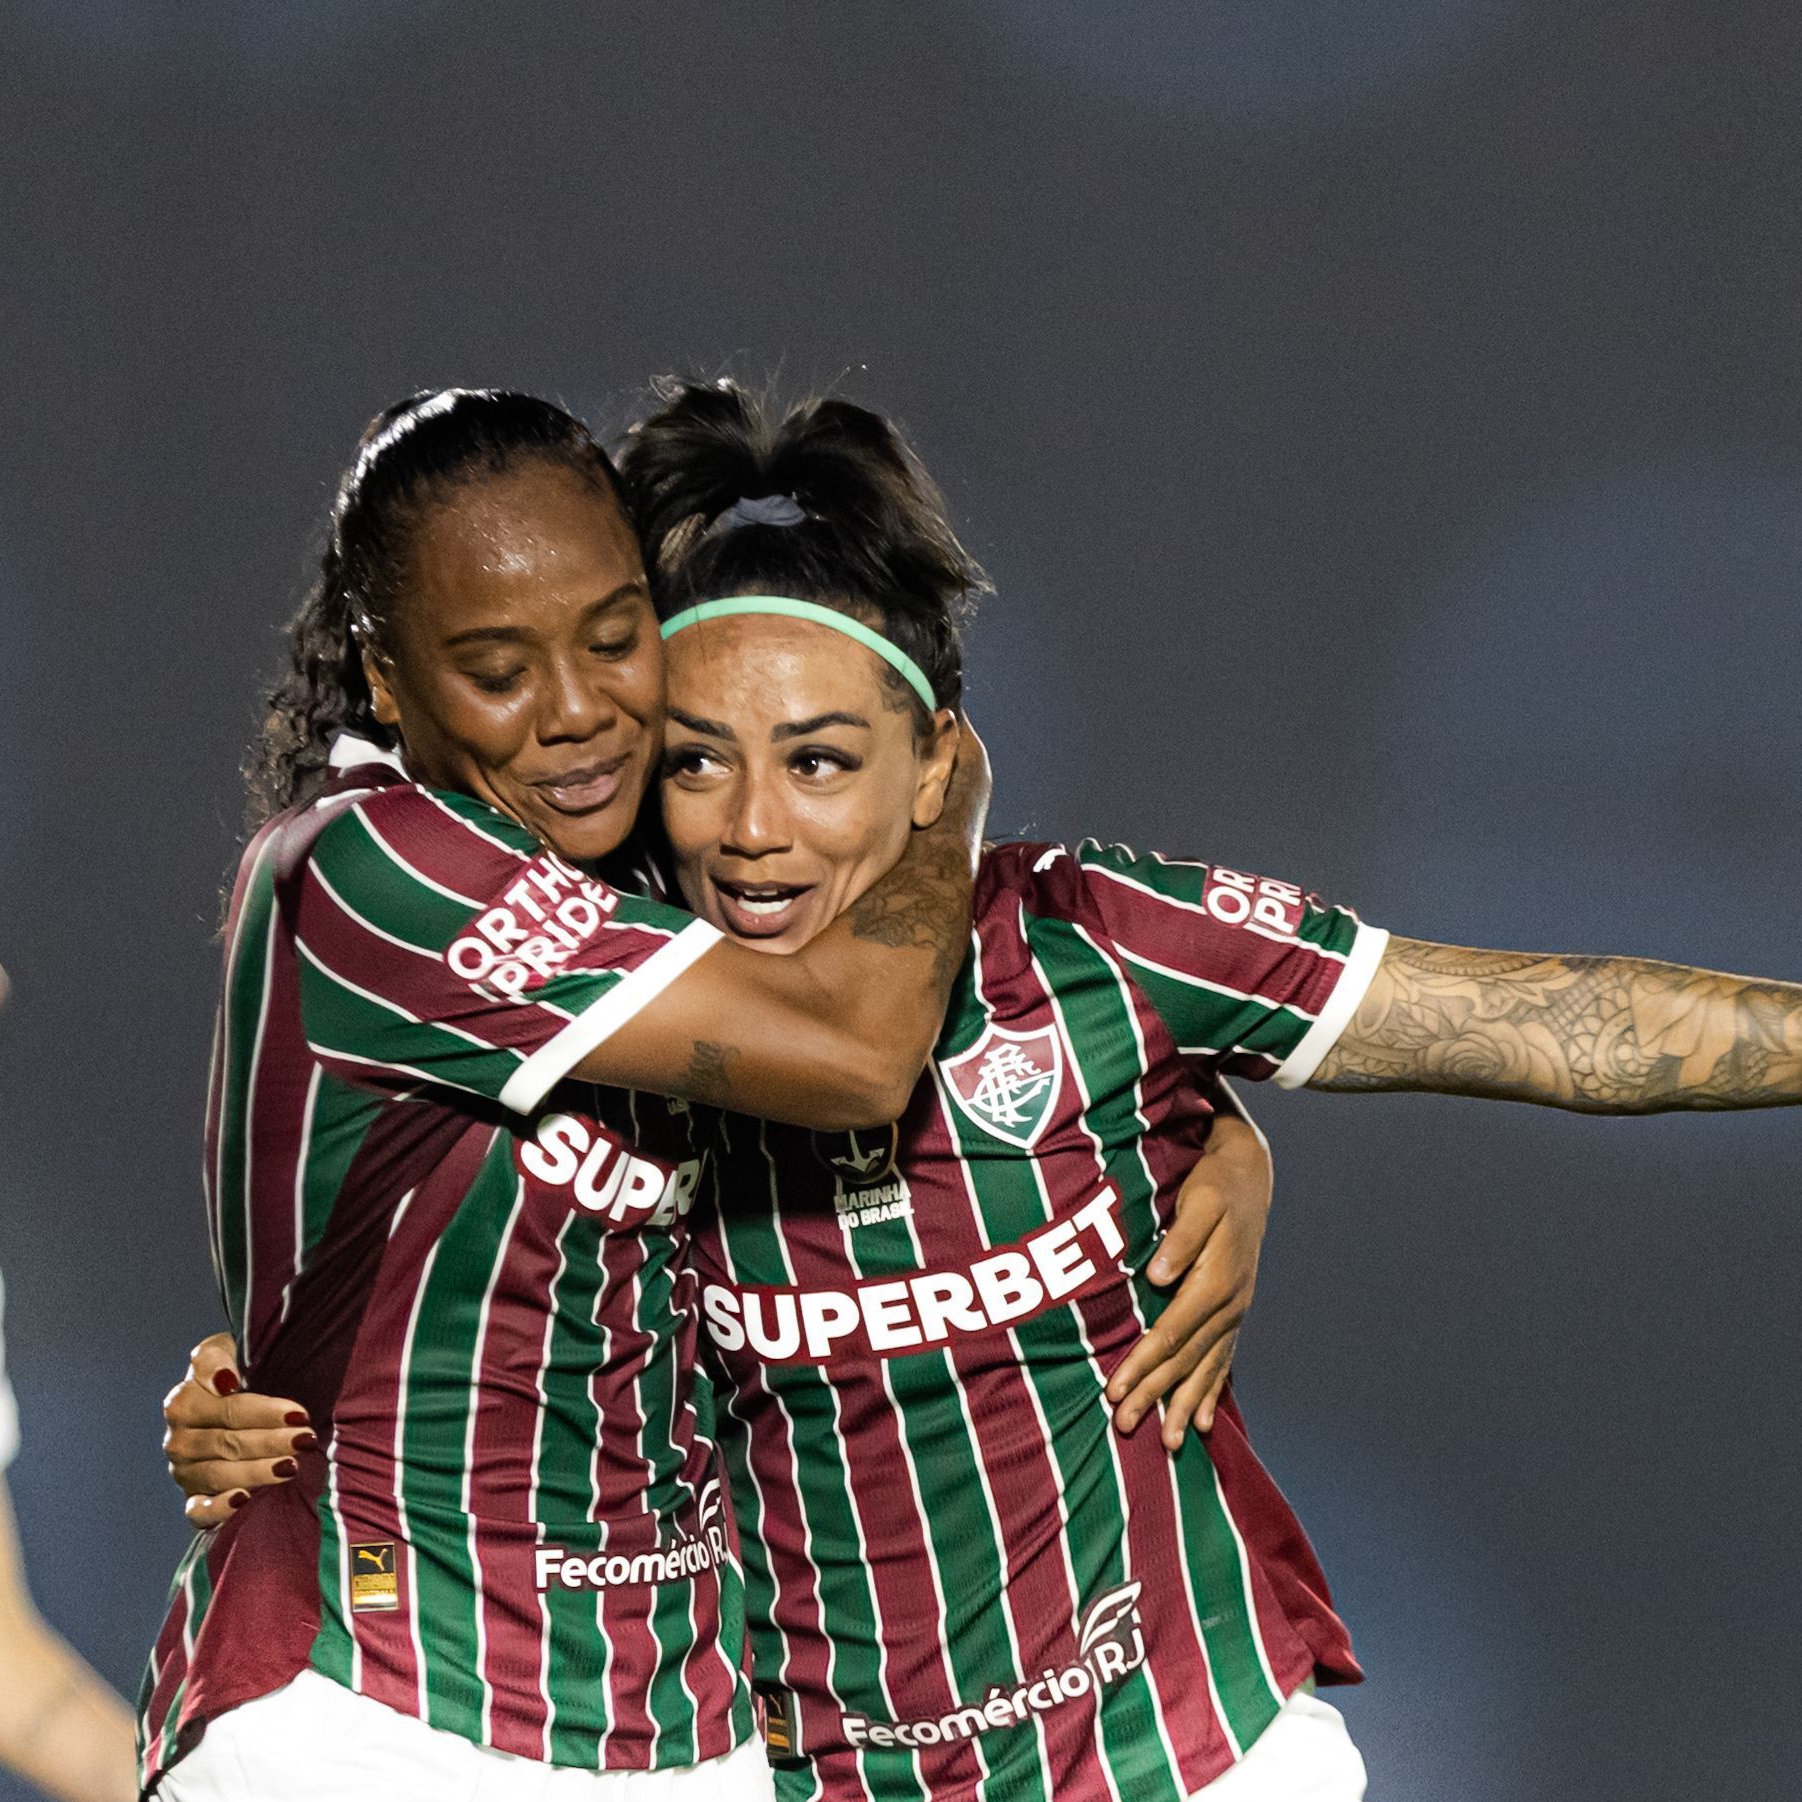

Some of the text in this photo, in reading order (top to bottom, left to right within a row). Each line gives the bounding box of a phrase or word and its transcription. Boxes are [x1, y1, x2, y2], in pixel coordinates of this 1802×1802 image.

[488, 881, 618, 998] PRIDE
[703, 1185, 1125, 1360] SUPERBET
[838, 1210, 859, 1230] DO
[535, 1534, 710, 1588] Fecomércio
[842, 1667, 1090, 1747] Fecomércio
[1095, 1629, 1145, 1684] RJ
